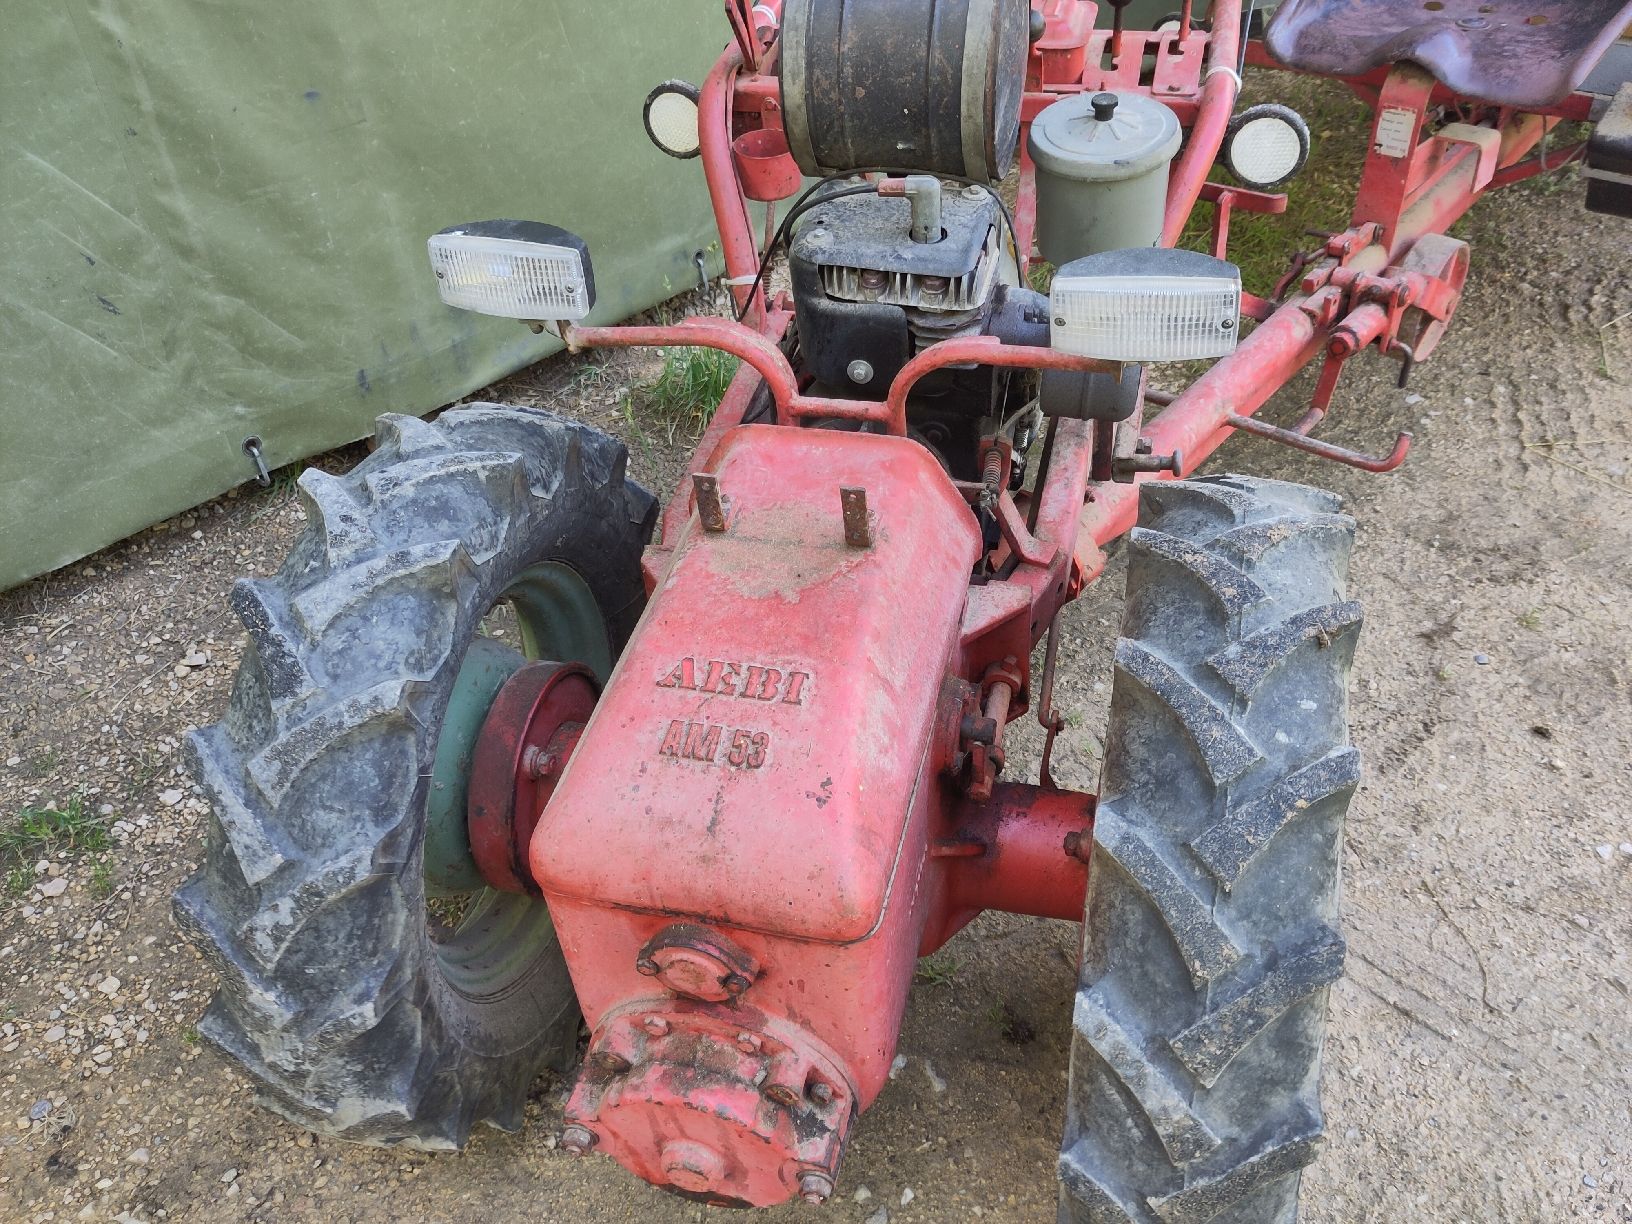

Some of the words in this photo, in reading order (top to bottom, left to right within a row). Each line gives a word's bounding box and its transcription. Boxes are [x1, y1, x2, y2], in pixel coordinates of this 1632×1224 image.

[655, 656, 810, 706] AEBI
[658, 719, 723, 763] AM
[728, 728, 770, 770] 53
